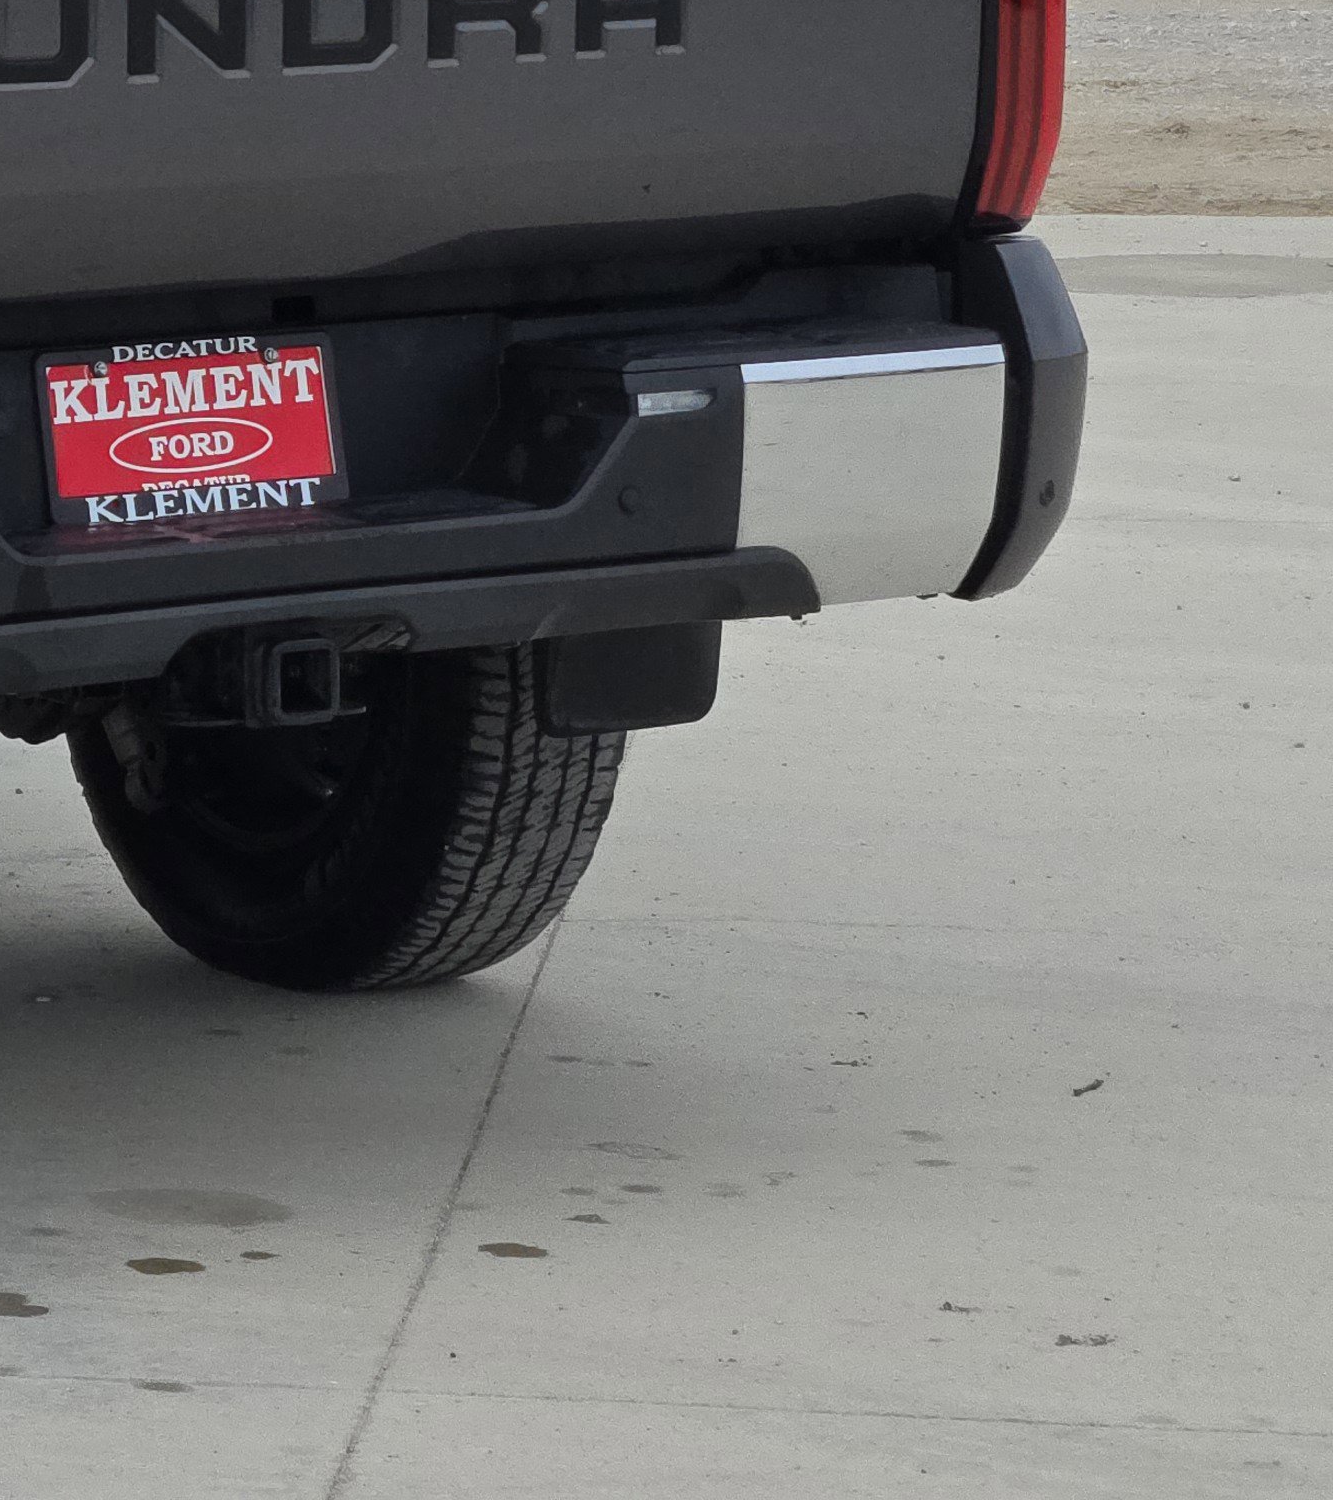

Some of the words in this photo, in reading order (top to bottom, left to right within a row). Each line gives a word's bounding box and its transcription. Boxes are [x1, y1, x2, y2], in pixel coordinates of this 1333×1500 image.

[112, 336, 258, 363] DECATUR
[52, 358, 319, 424] KLEMENT
[150, 431, 234, 461] FORD
[85, 477, 321, 524] KLEMENT
